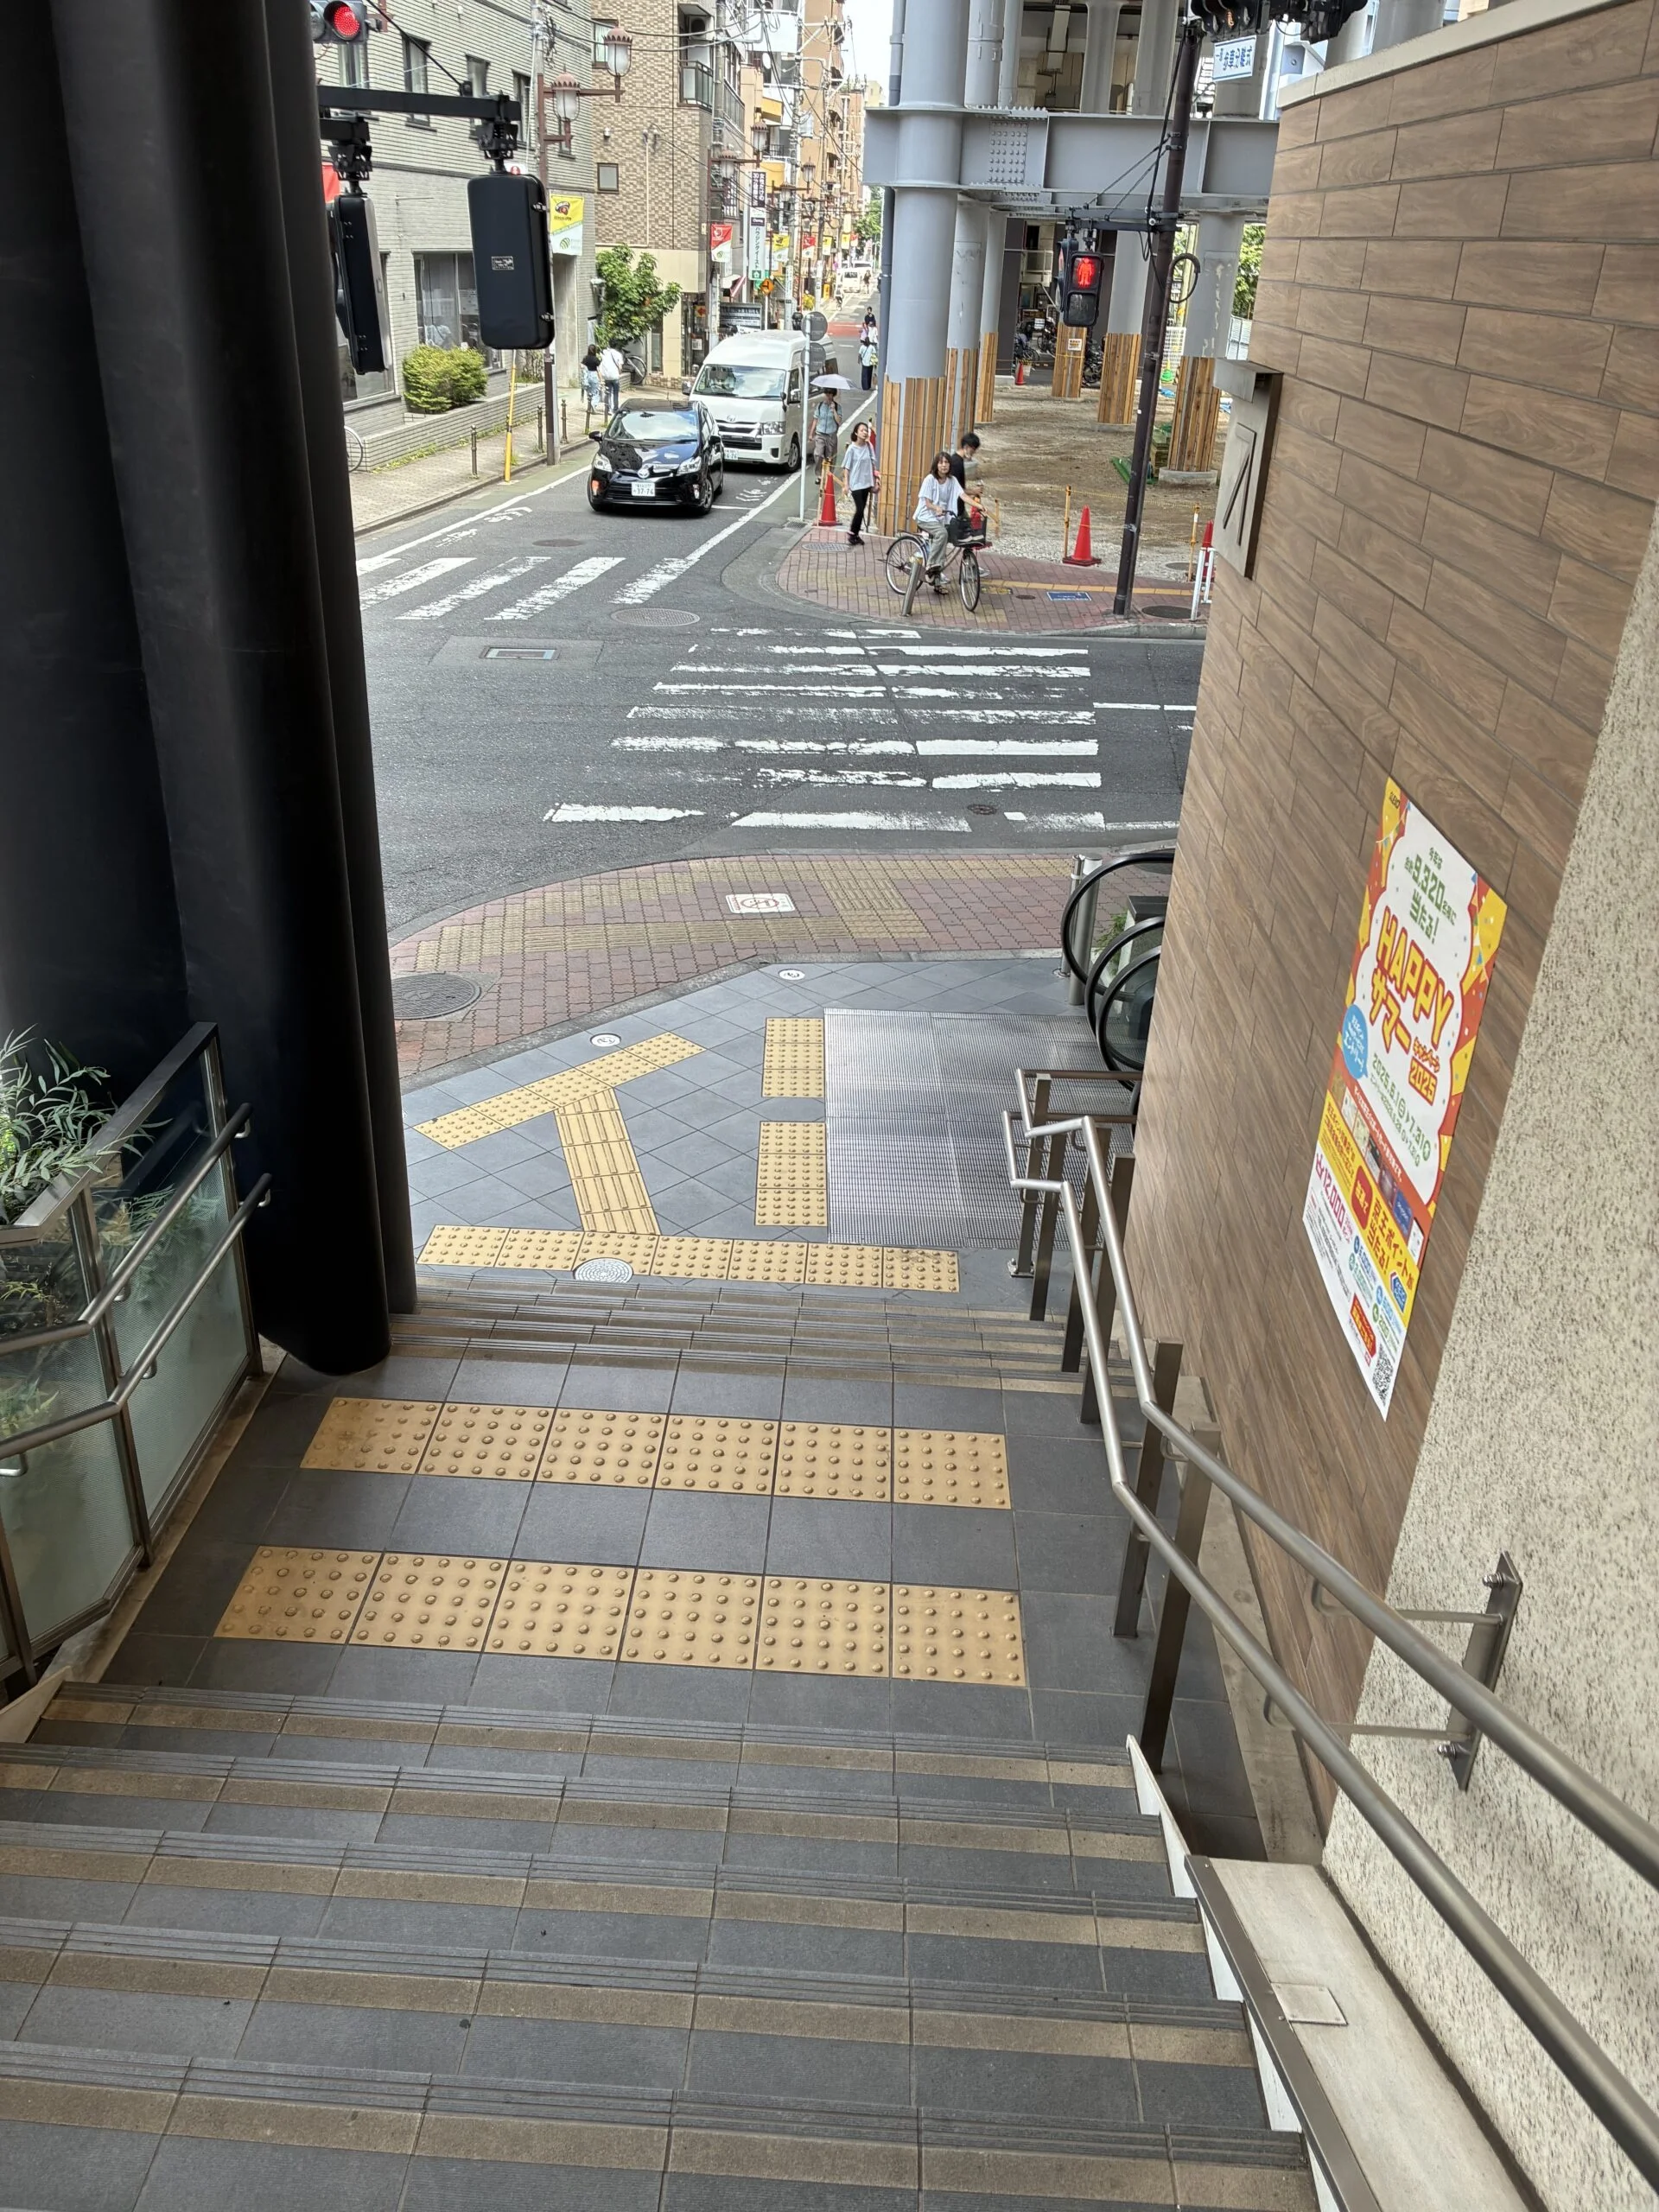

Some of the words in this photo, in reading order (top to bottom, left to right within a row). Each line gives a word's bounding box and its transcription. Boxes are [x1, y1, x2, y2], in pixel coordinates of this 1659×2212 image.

[1369, 968, 1412, 1054] サマー
[1376, 906, 1454, 1050] HAPPY
[1409, 1059, 1437, 1104] 2025
[1371, 1198, 1414, 1291] 京王ポイントが
